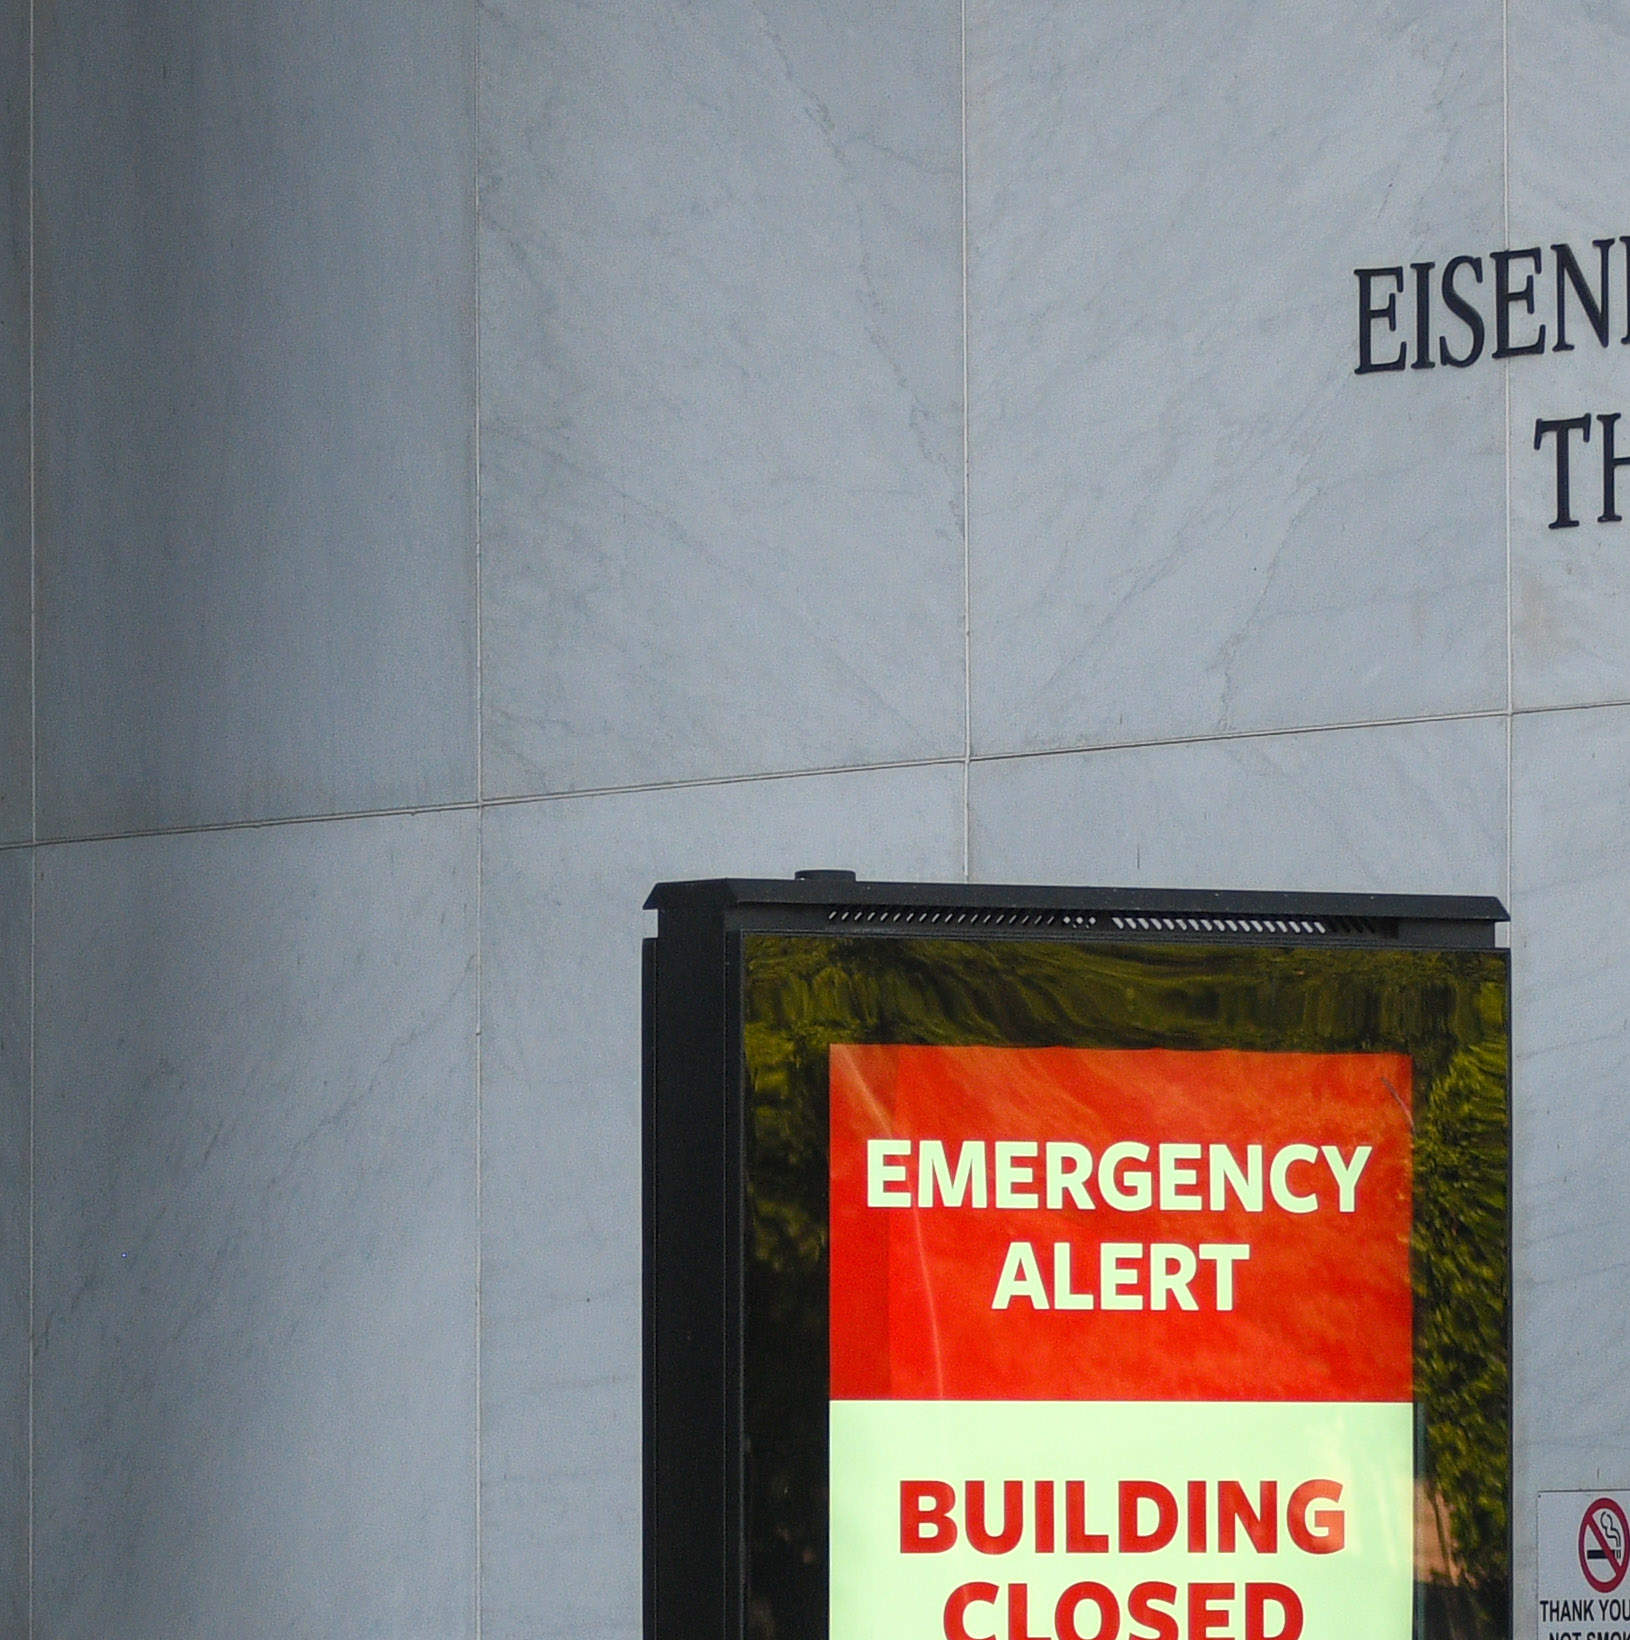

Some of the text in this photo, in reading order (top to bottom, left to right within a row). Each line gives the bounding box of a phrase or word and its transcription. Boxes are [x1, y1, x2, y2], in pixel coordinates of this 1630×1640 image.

[865, 1138, 1373, 1214] EMERGENCY
[991, 1242, 1251, 1312] ALERT
[899, 1478, 1347, 1555] BUILDING
[1540, 1599, 1595, 1622] THANK
